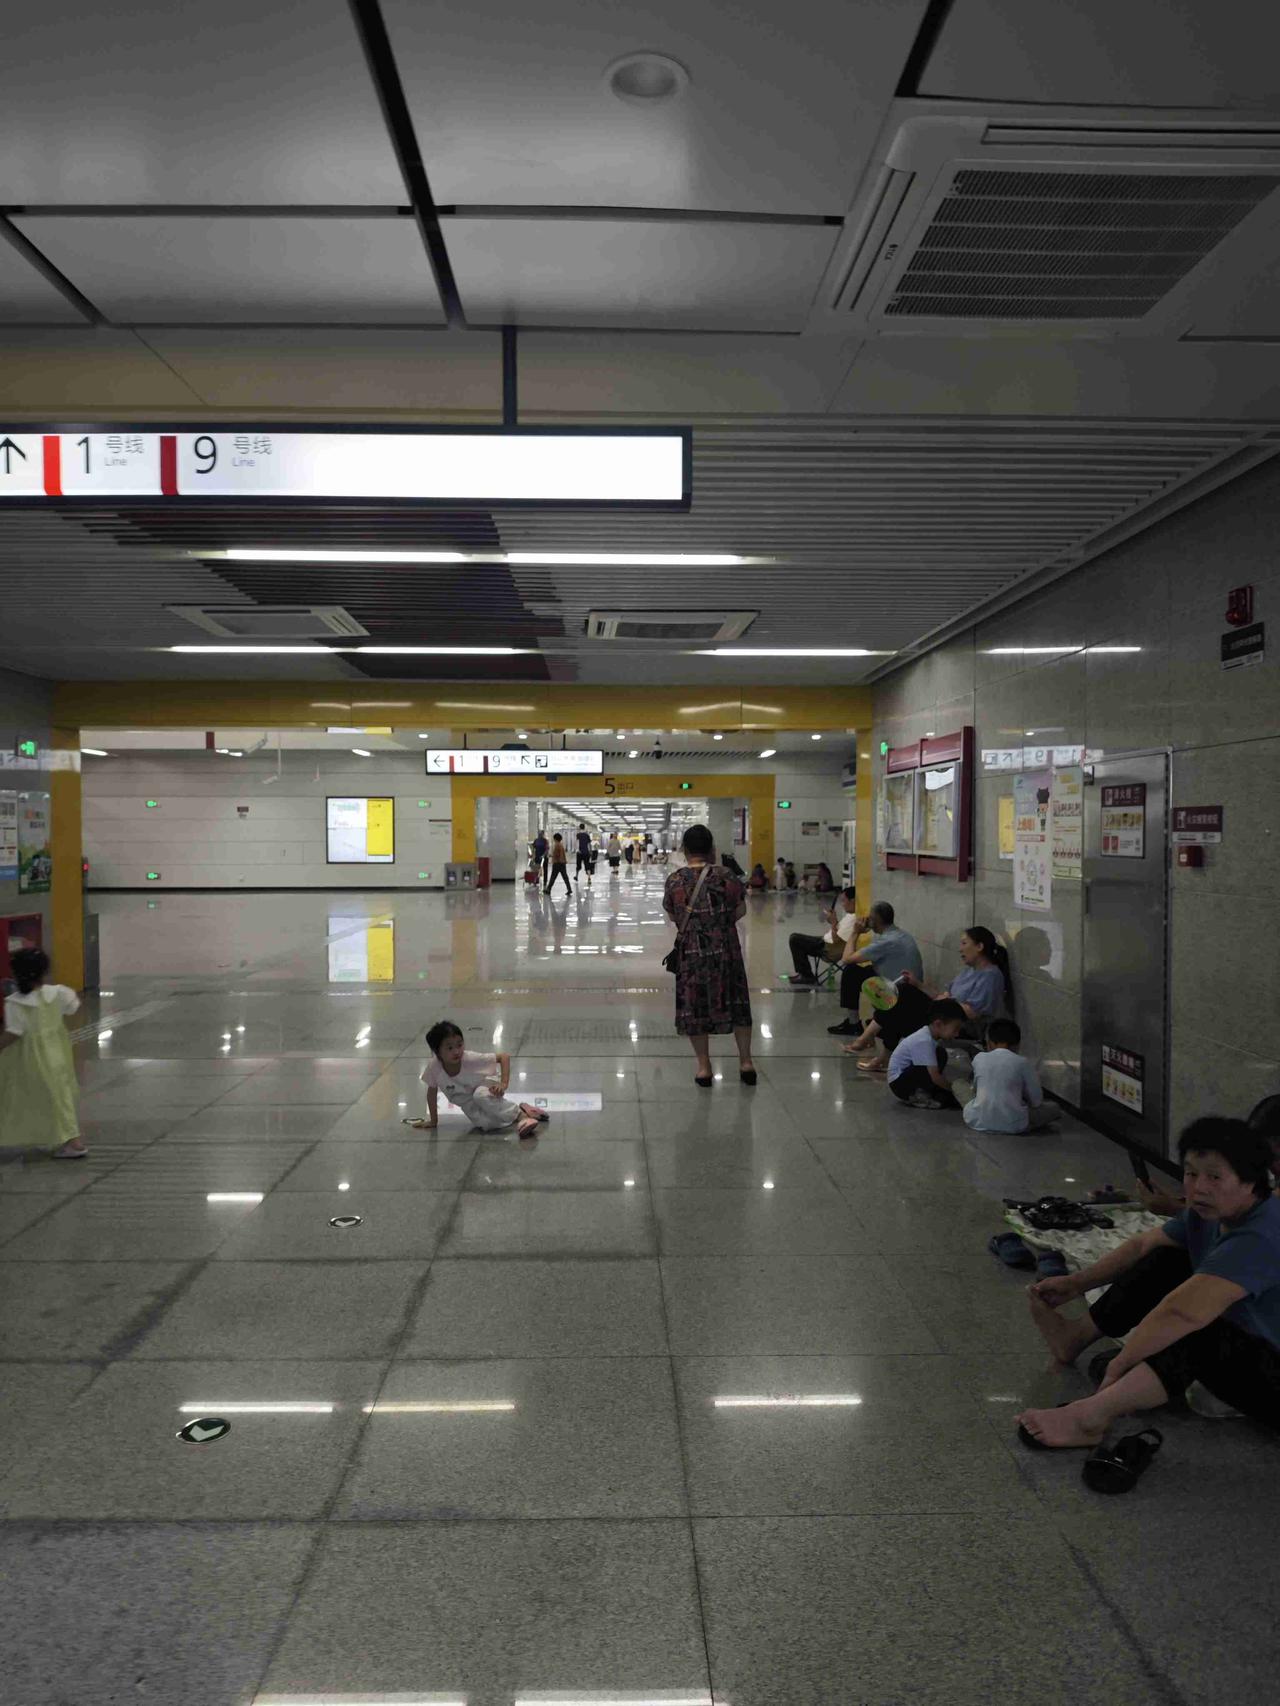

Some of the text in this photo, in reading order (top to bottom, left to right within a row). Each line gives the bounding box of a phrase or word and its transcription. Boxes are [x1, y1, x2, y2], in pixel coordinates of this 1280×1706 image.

[76, 435, 273, 474] 1 号线 9 号线
[104, 456, 256, 468] Line Line
[492, 755, 501, 768] 9
[604, 777, 616, 794] 5
